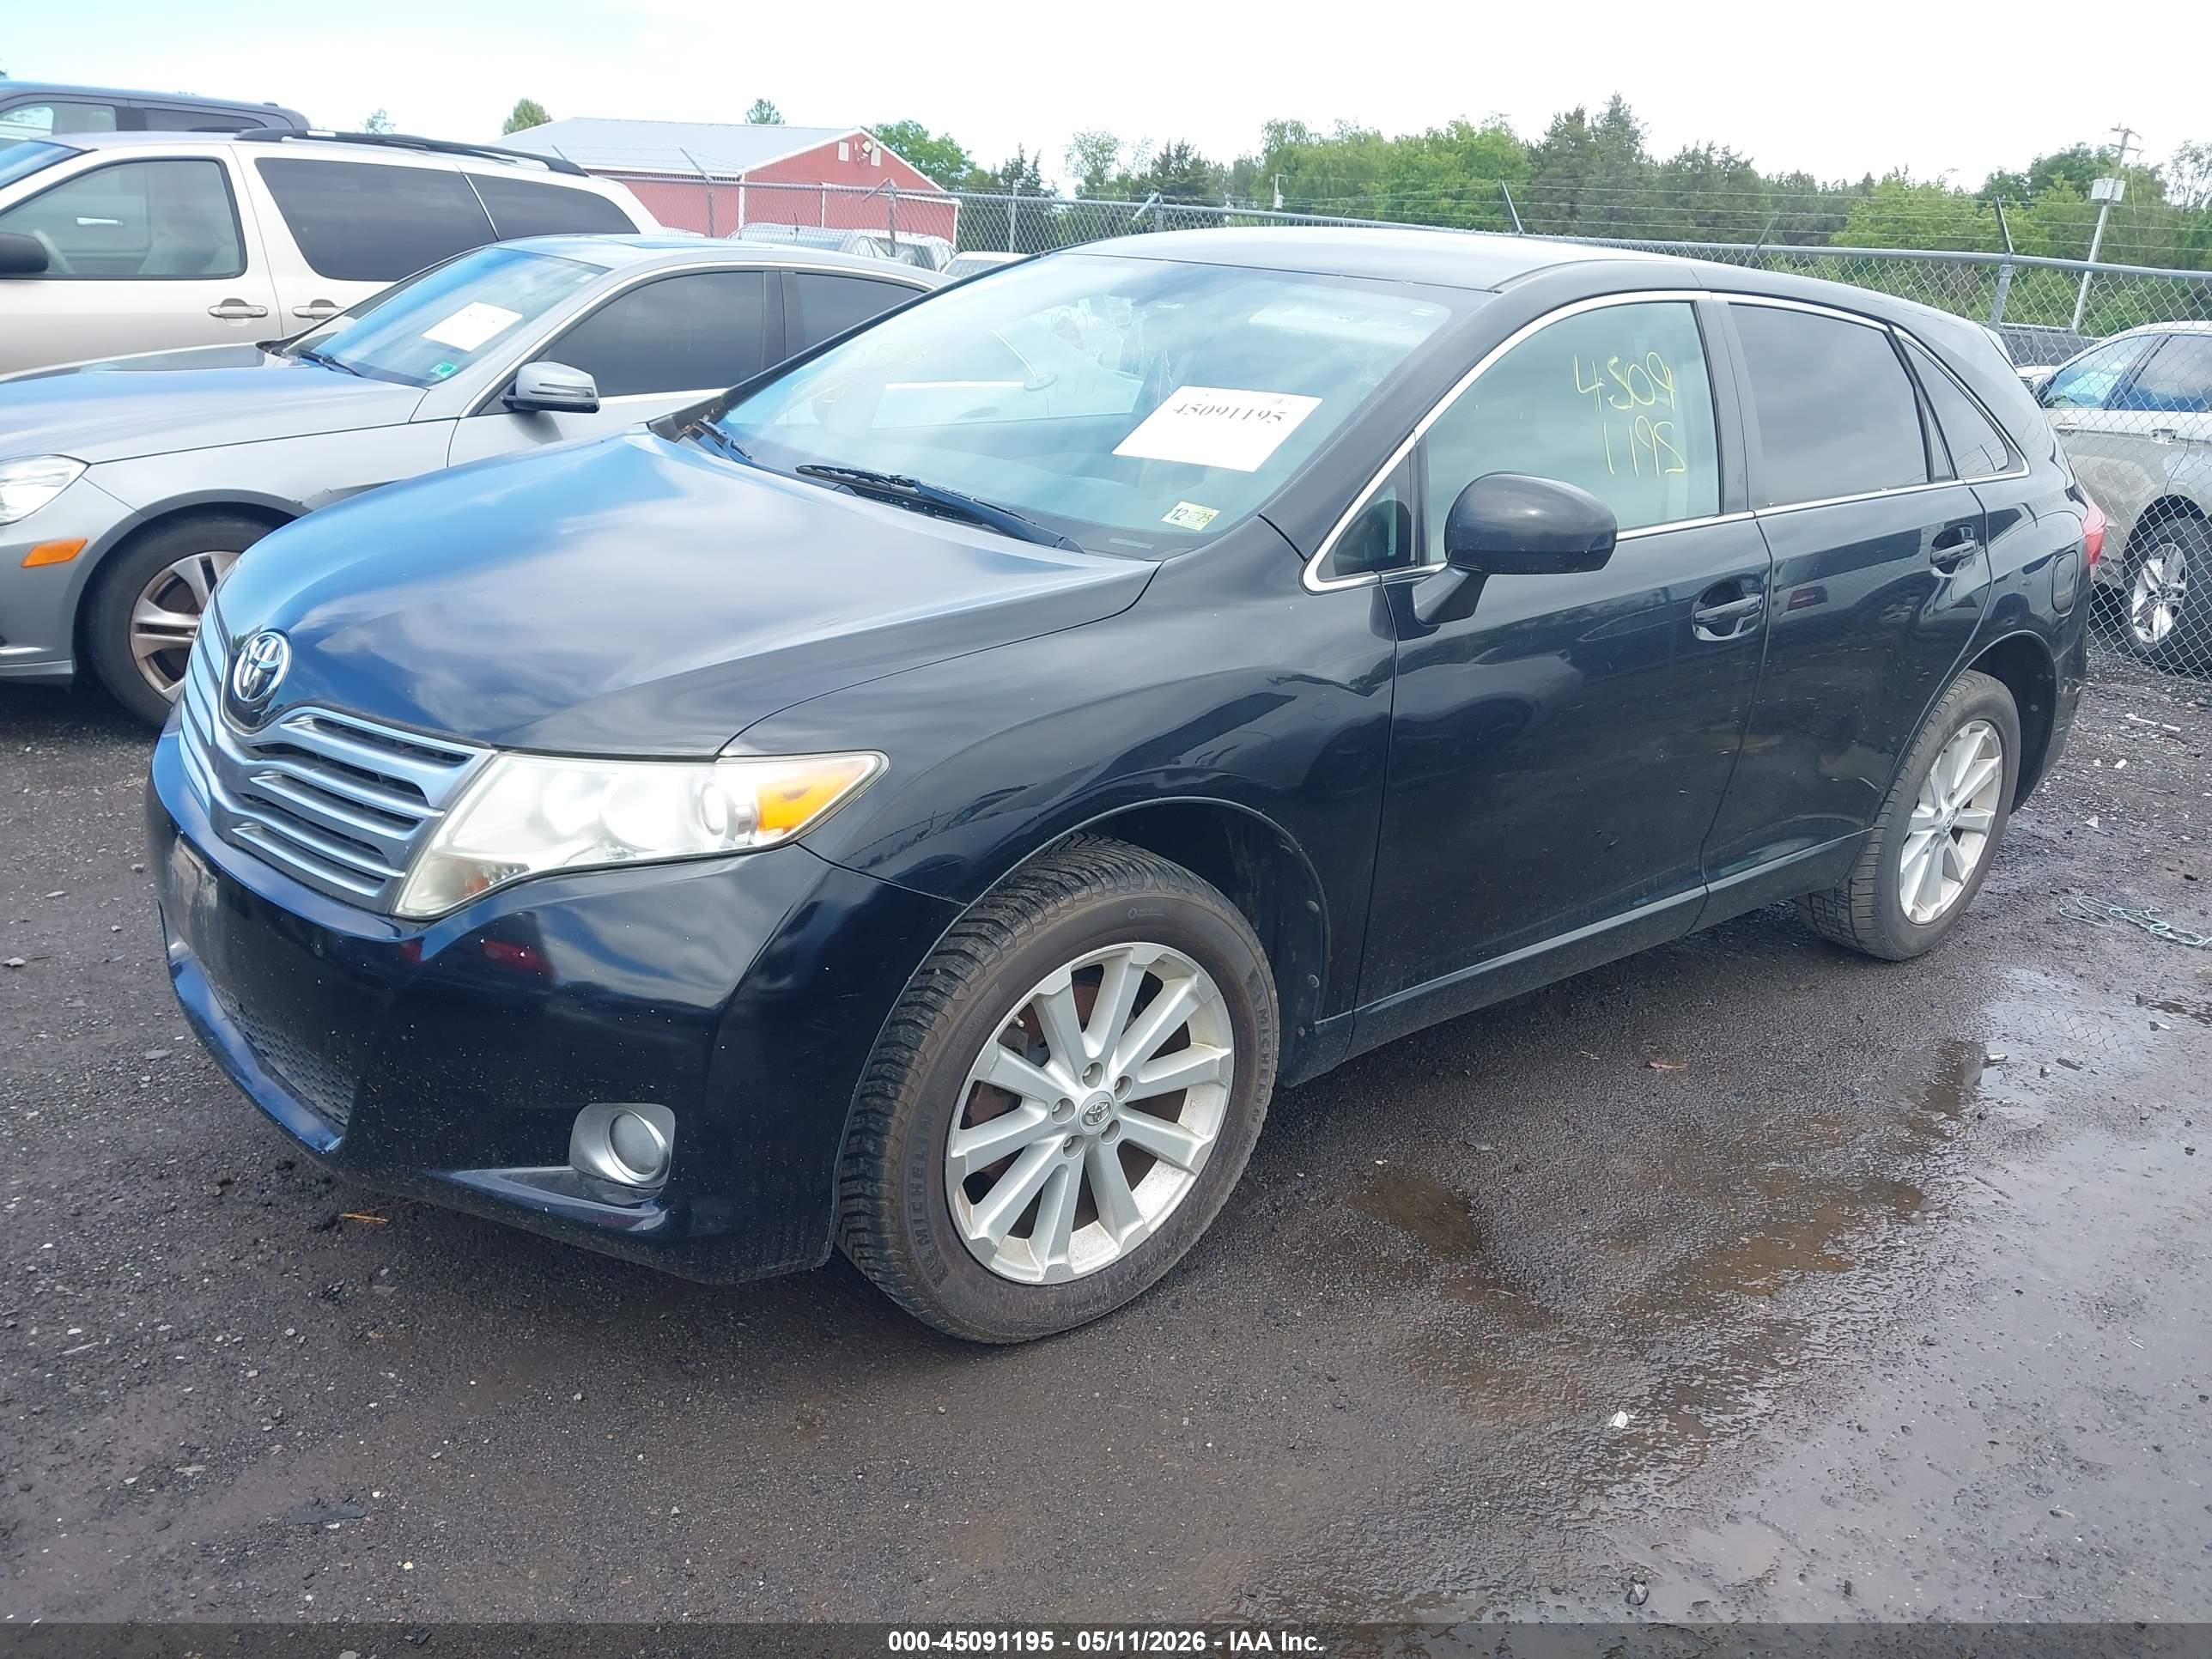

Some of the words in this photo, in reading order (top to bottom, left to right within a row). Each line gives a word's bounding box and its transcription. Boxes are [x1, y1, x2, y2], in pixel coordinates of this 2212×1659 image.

[1573, 351, 1676, 412] 4509
[1173, 403, 1287, 424] 45091195
[1603, 415, 1686, 477] 1195
[1170, 507, 1189, 521] 12
